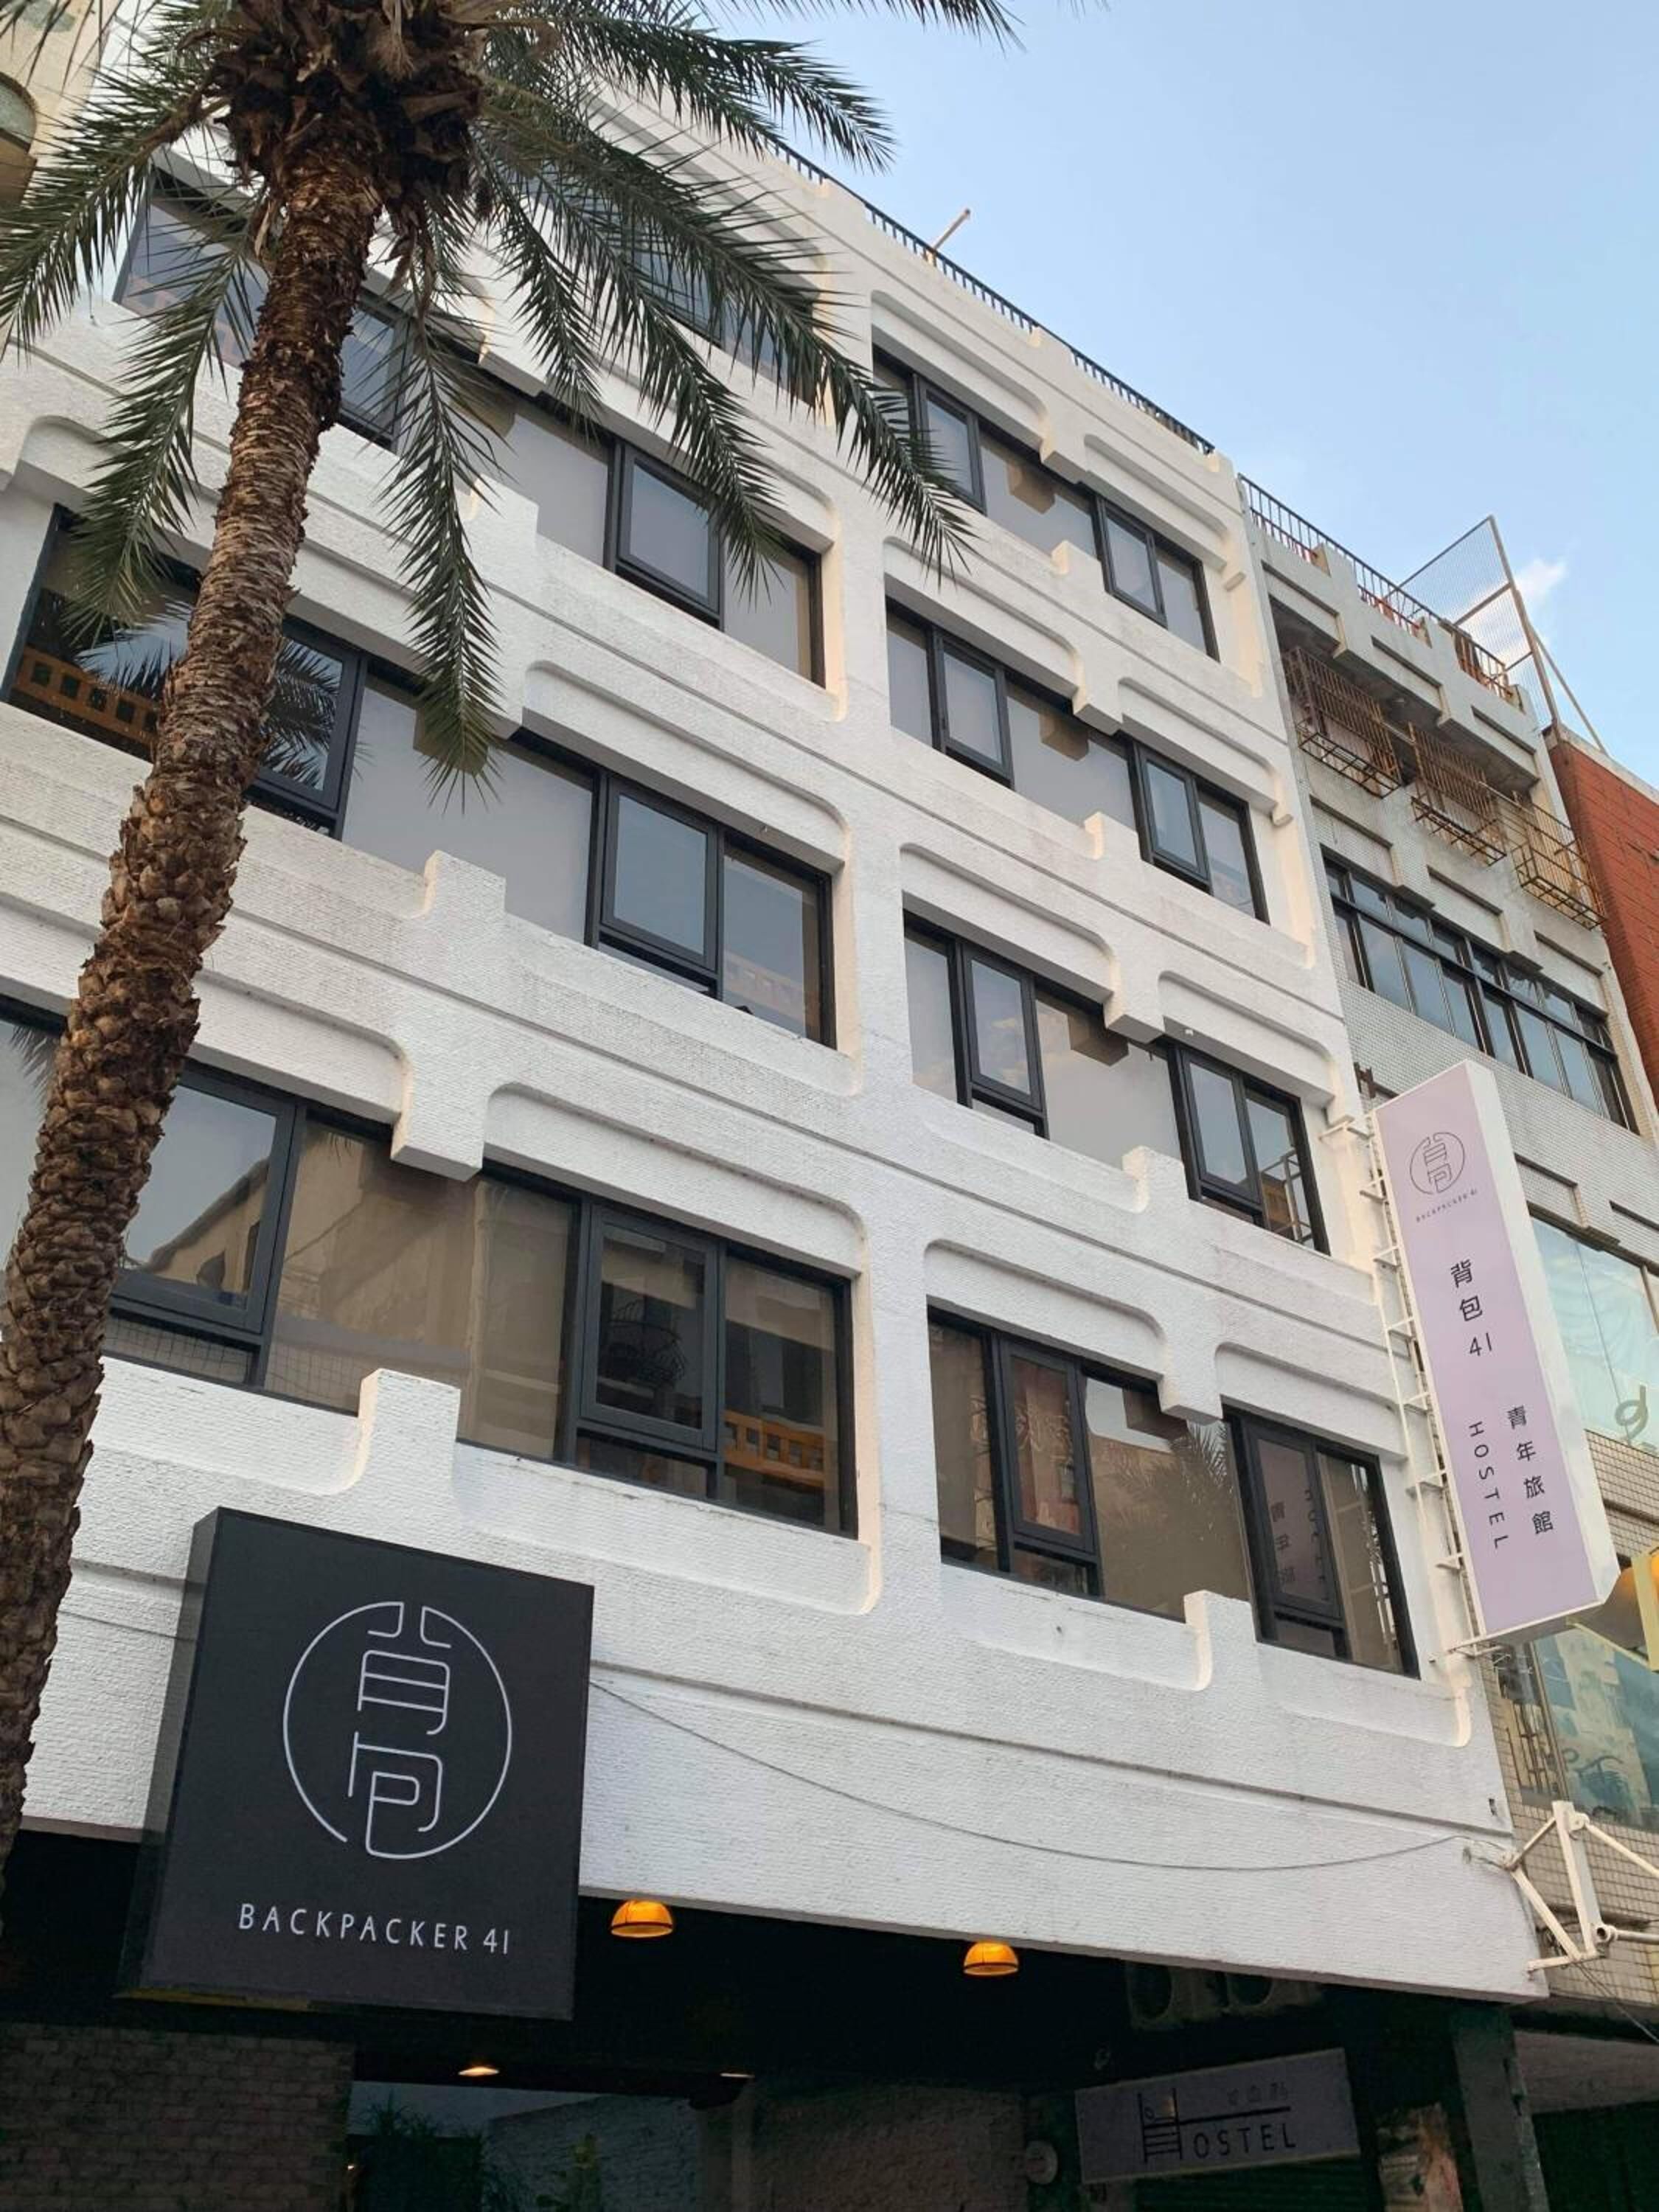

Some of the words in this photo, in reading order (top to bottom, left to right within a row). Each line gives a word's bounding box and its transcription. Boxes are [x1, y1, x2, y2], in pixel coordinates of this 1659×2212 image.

[1469, 1421, 1509, 1549] HOSTEL
[1508, 1405, 1554, 1534] 青年旅館
[239, 1903, 467, 1950] BACKPACKER
[483, 1928, 509, 1954] 41
